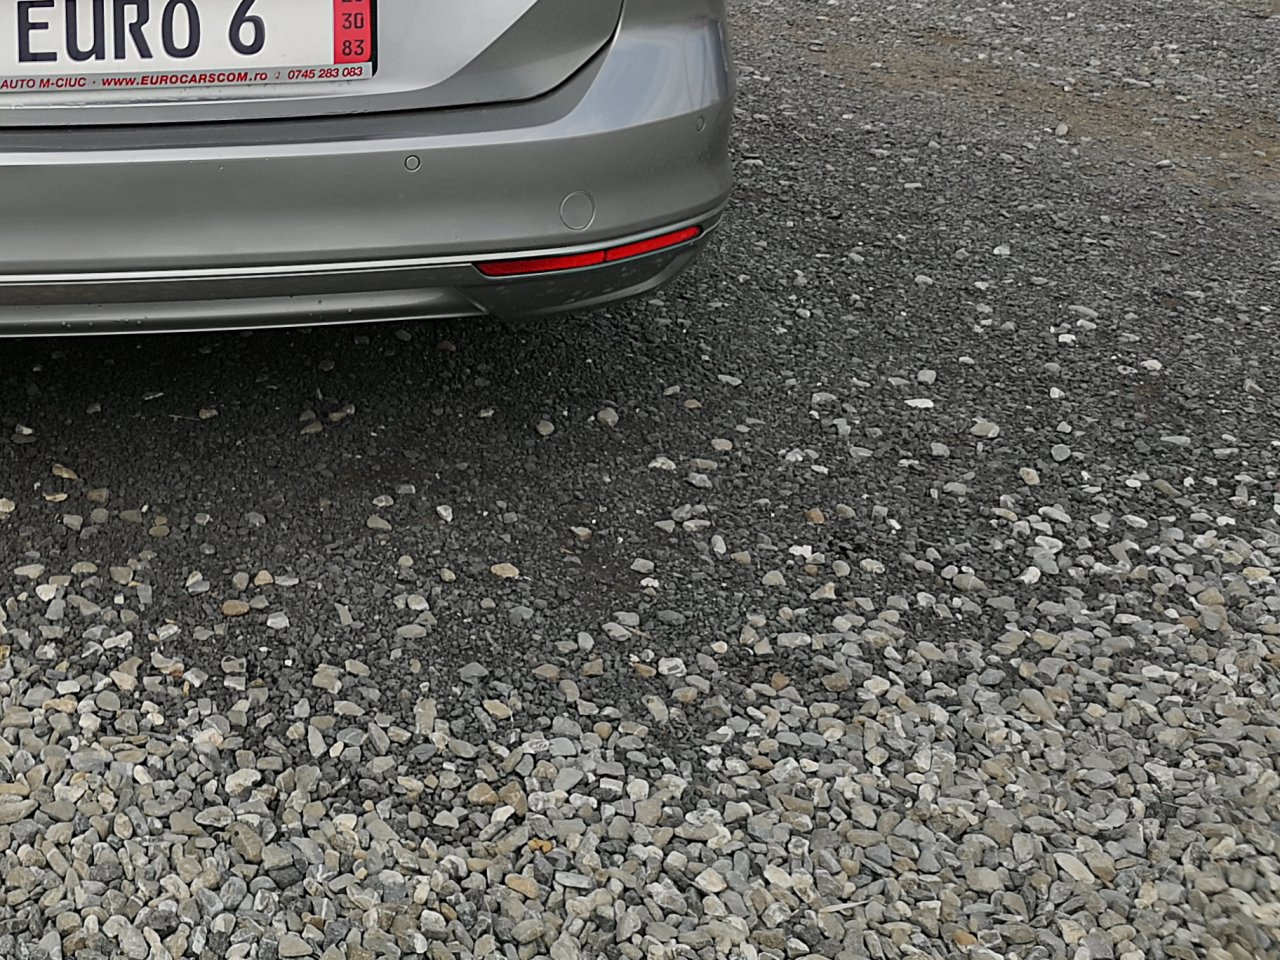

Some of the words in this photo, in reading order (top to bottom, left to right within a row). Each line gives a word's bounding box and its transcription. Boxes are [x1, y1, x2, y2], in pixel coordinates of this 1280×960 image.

[342, 12, 364, 29] 30
[342, 40, 364, 56] 83
[0, 78, 36, 89] AUTO
[39, 77, 87, 88] M-CIUC
[102, 72, 267, 87] www.EUROCARSCOM.ro
[288, 69, 316, 80] 0745
[318, 68, 340, 79] 283
[342, 66, 363, 77] 083
